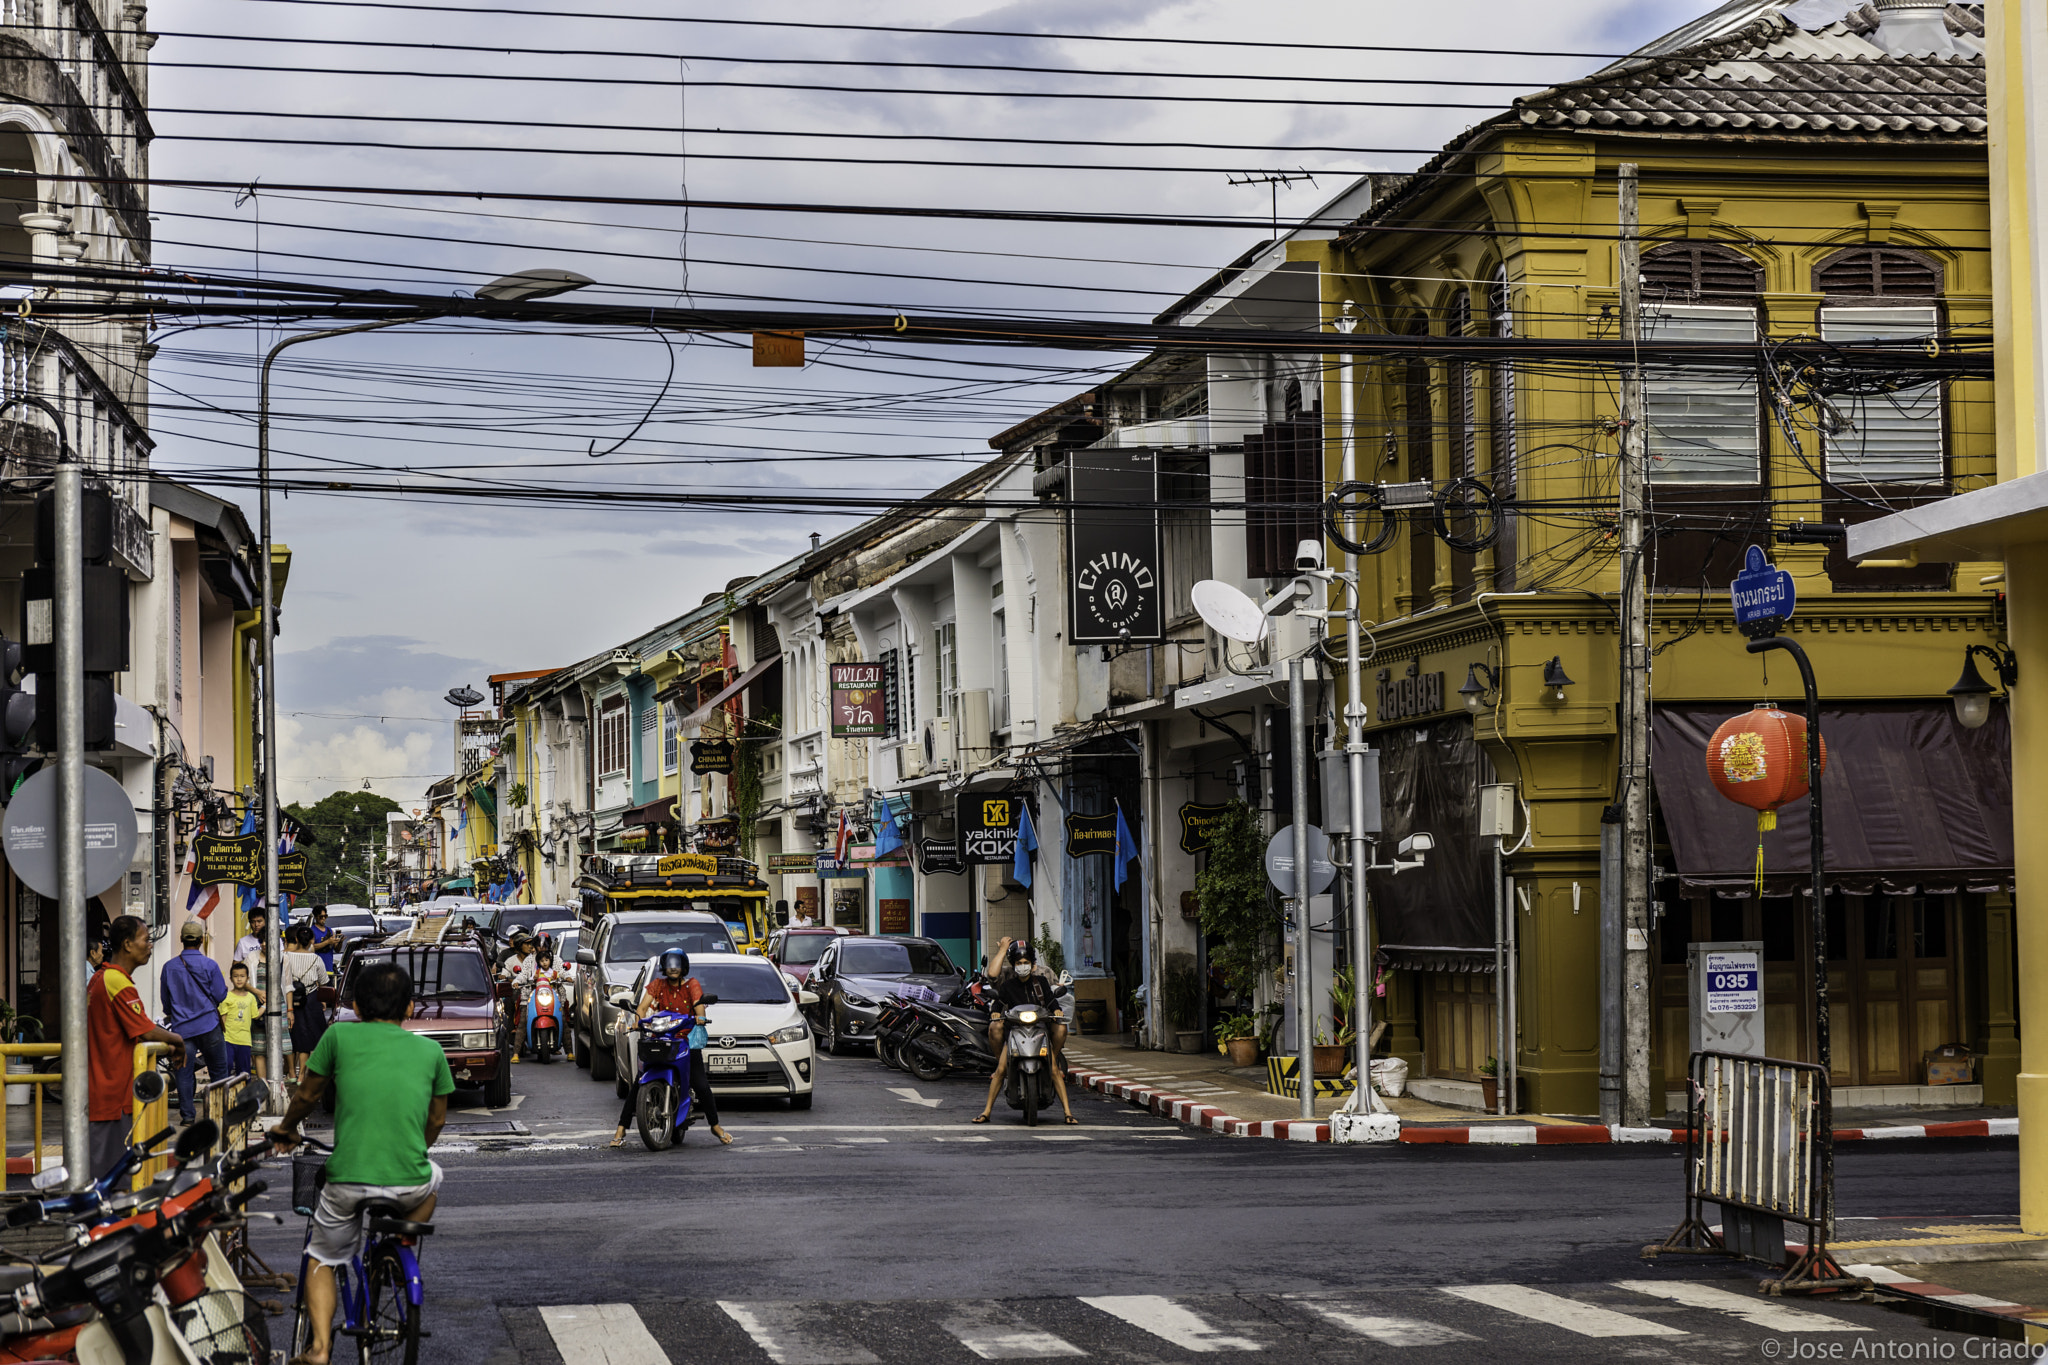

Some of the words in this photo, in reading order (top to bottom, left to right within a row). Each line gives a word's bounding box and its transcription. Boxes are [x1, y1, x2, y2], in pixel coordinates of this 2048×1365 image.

[1078, 551, 1154, 590] CHINO
[1735, 573, 1785, 609] ถนนกระบี่
[1748, 610, 1762, 619] KRABI
[1763, 607, 1776, 616] ROAD
[835, 667, 880, 682] WILAI
[841, 705, 874, 725] วิไล
[846, 725, 874, 733] ร้านอาหาร
[965, 828, 1018, 840] yakinik
[209, 843, 242, 855] ภูเก็ตการ์ด
[965, 841, 1017, 855] KOK
[203, 855, 228, 863] PHUKET
[229, 855, 248, 863] CARD
[360, 958, 380, 966] TOT
[1715, 973, 1749, 989] 035
